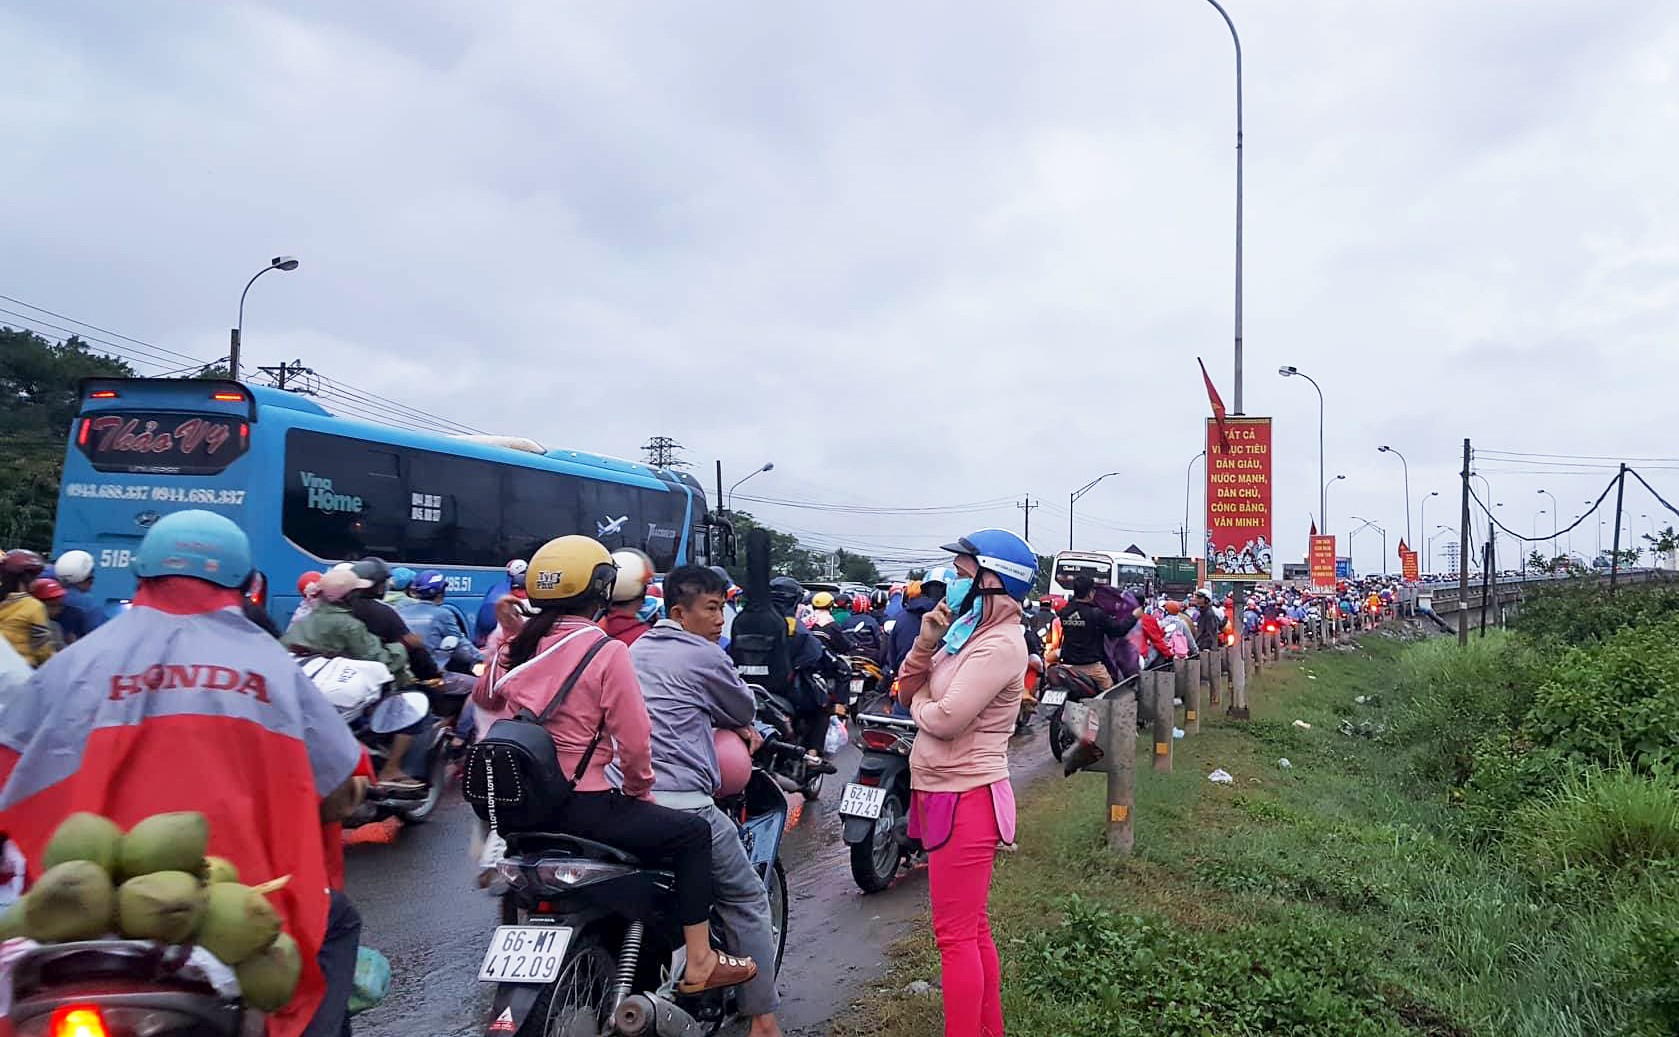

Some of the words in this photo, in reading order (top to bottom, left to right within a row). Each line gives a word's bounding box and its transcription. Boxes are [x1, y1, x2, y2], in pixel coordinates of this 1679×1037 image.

[1245, 443, 1267, 454] TIÊU
[1216, 458, 1235, 469] DÂN
[1238, 474, 1268, 486] MẠNH,
[1217, 486, 1237, 498] DÂN
[1211, 501, 1237, 513] CÔNG
[1235, 517, 1259, 527] MINH
[108, 664, 271, 703] HONDA
[841, 799, 879, 817] 317.43
[485, 954, 557, 979] 412.09
